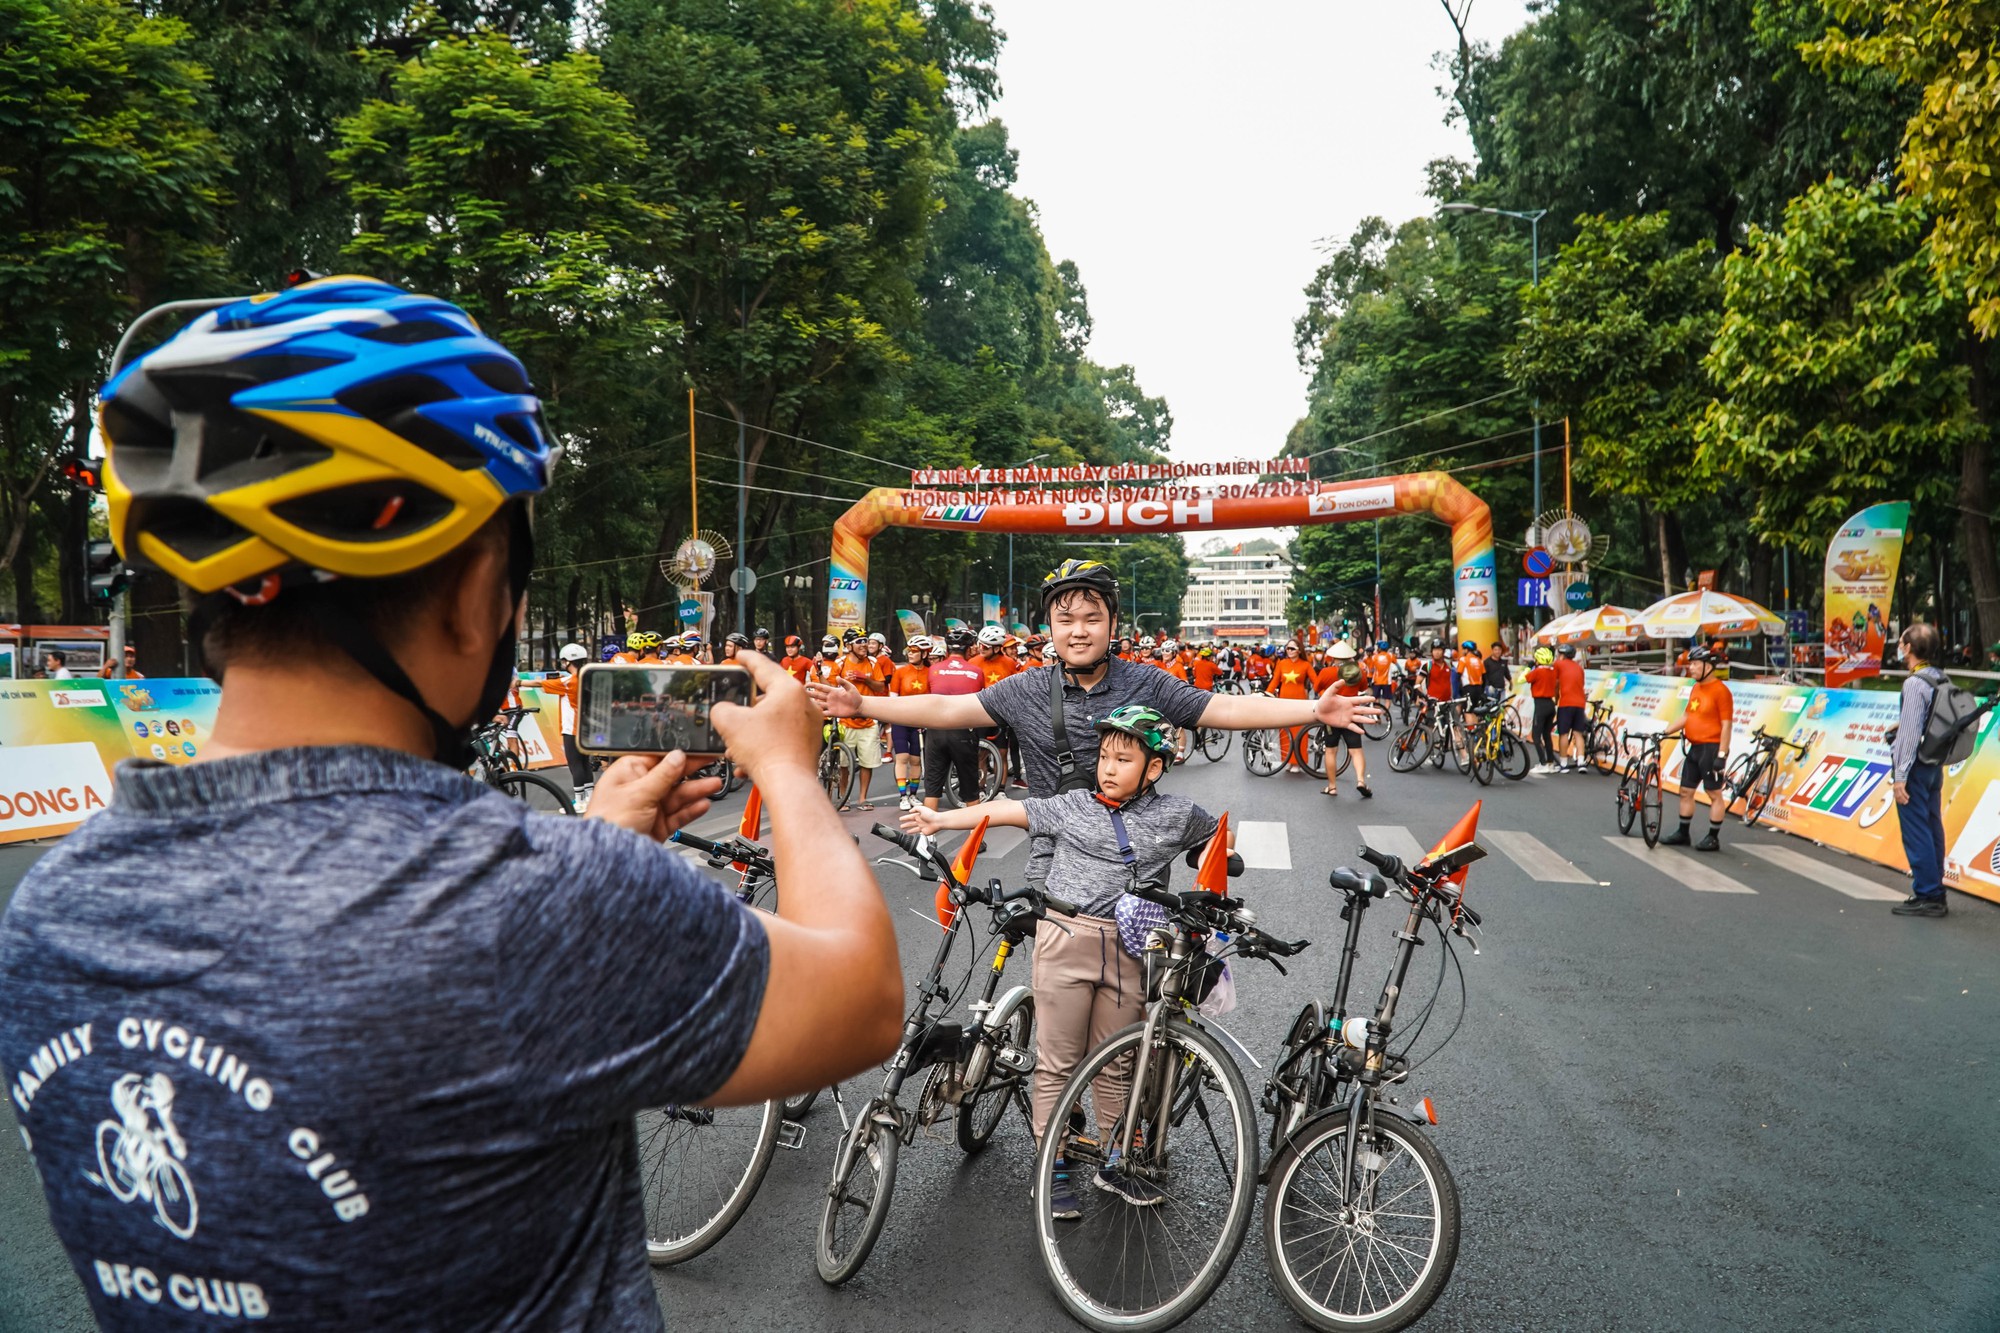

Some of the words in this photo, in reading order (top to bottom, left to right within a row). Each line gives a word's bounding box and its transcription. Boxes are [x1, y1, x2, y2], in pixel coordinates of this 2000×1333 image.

[939, 465, 981, 488] NIỆM
[986, 468, 1007, 483] 48
[1012, 463, 1052, 483] NĂM
[1058, 461, 1104, 481] NGÀY
[1108, 459, 1143, 480] GIẢI
[1148, 460, 1211, 480] PHÓNG
[1267, 457, 1310, 475] NAM
[901, 486, 960, 507] THỐNG
[964, 486, 1010, 506] NHẤT
[1015, 485, 1047, 505] ĐẤT
[1106, 485, 1201, 504] (30/4/1975
[1218, 479, 1322, 499] 30/4/2023)
[924, 504, 986, 521] HTV
[1337, 501, 1355, 510] TON
[1356, 498, 1380, 507] DONG
[1460, 566, 1493, 580] HTV
[830, 578, 861, 590] HTV
[1468, 590, 1488, 607] 25
[1566, 592, 1585, 600] BIDV
[680, 609, 696, 617] BIDV
[54, 693, 71, 705] 25
[0, 787, 79, 820] DONG
[84, 785, 106, 810] A
[13, 1022, 93, 1113] FAMILY
[117, 1016, 273, 1112] CYCLING
[288, 1127, 370, 1223] CLUB
[94, 1259, 162, 1304] BFC
[168, 1273, 270, 1319] CLUB
